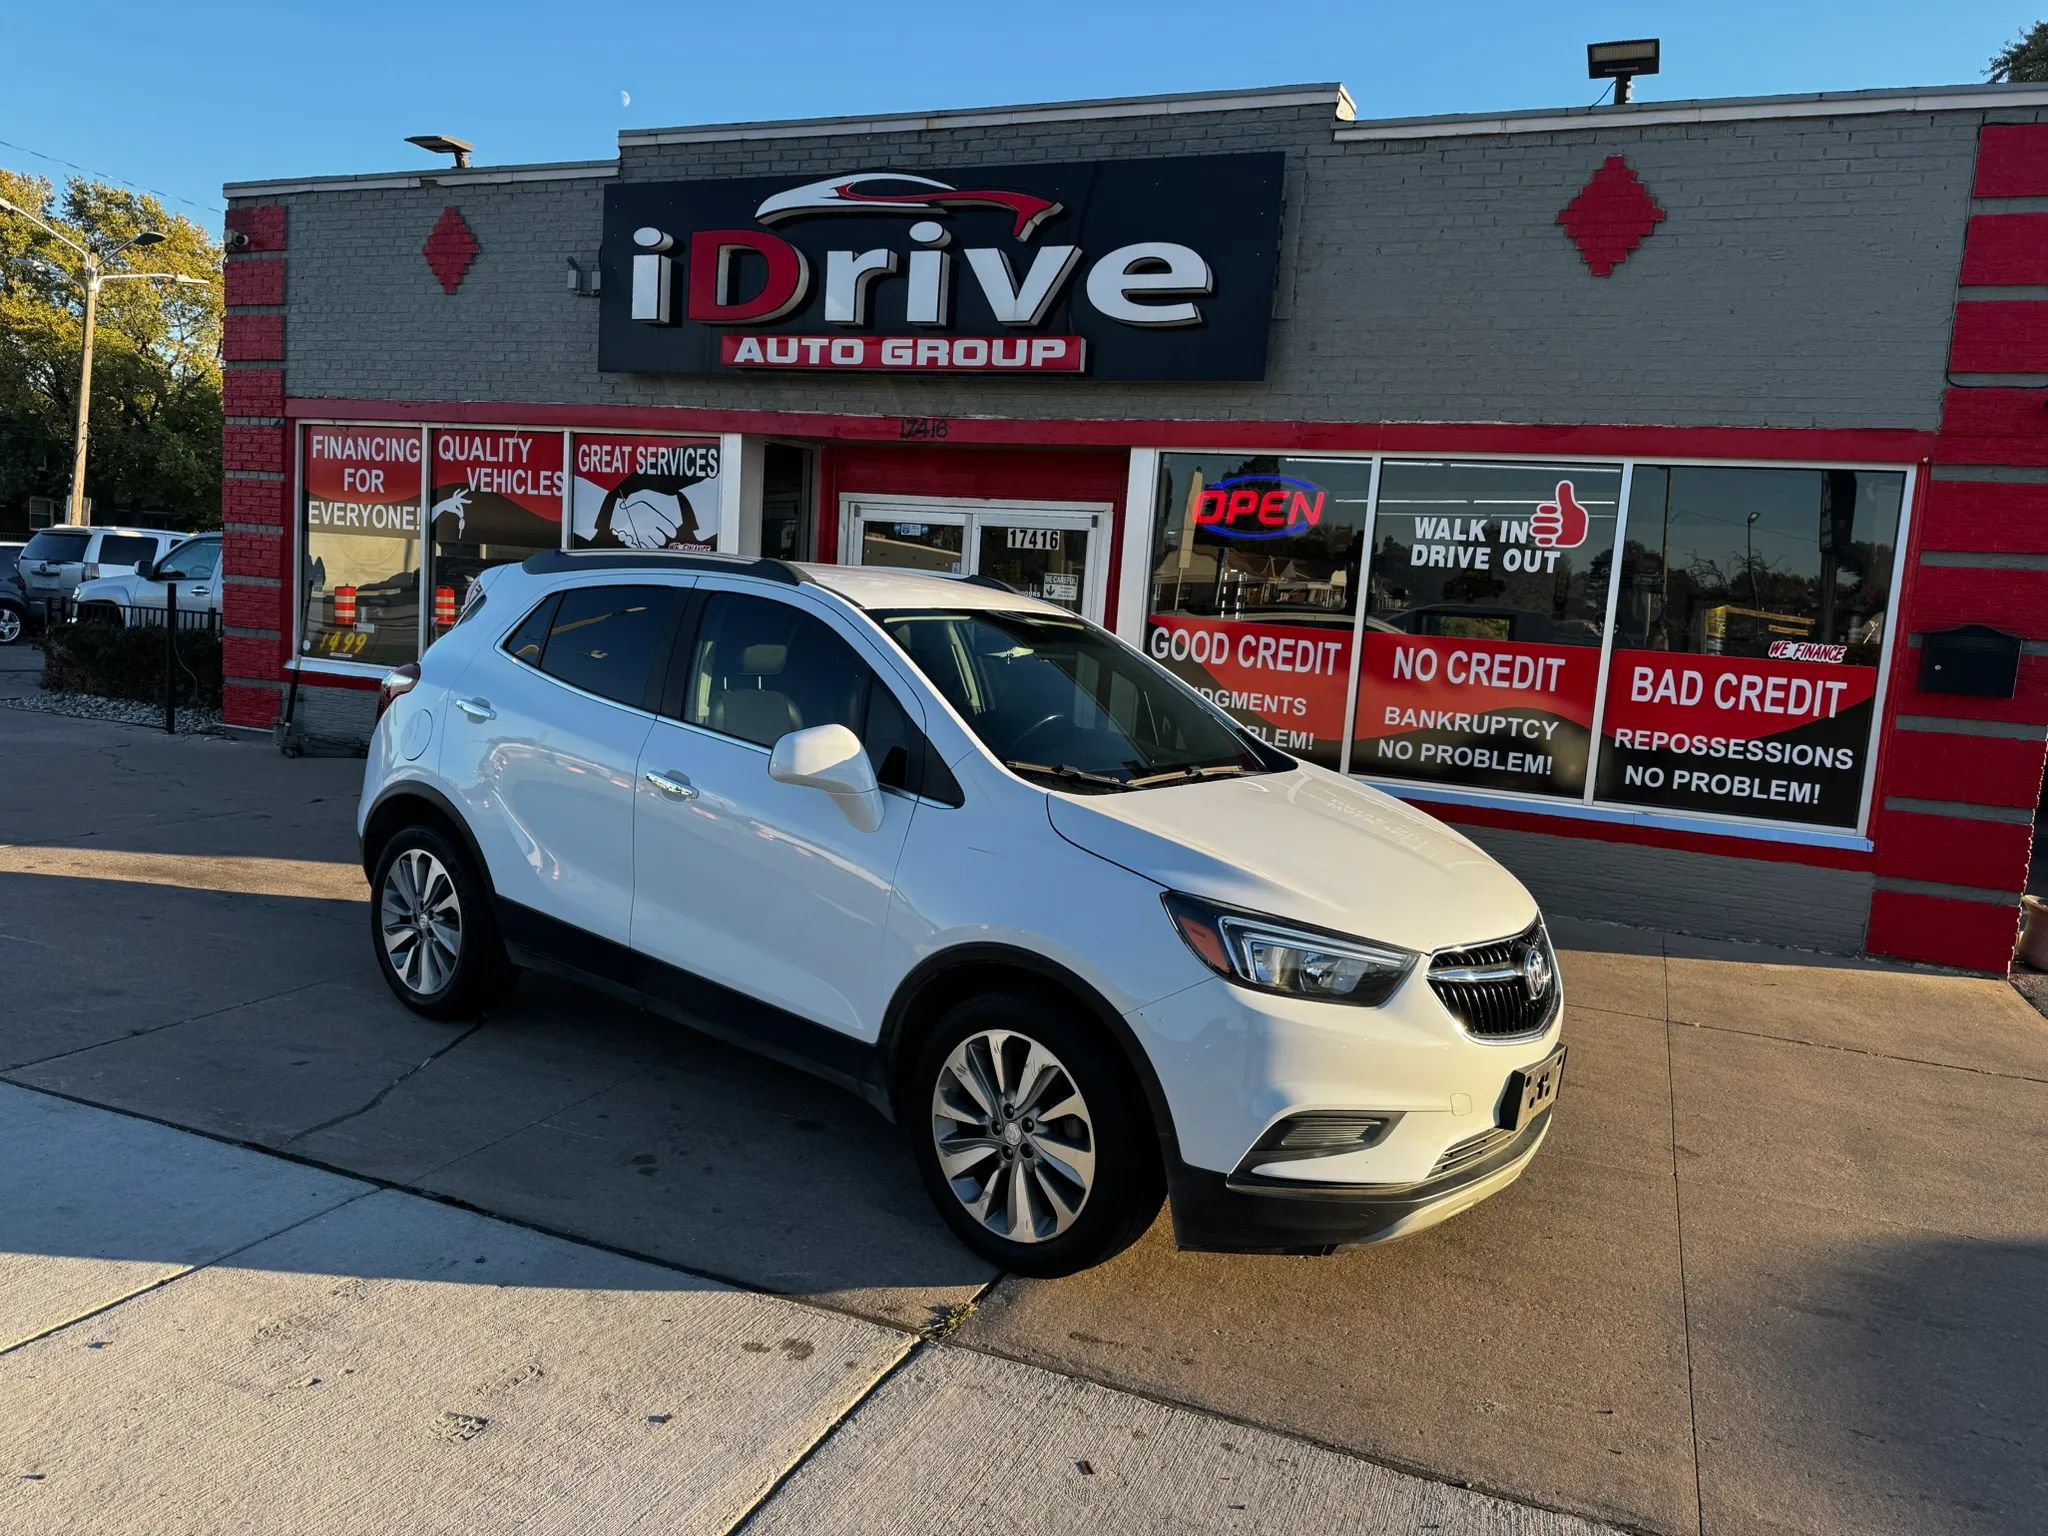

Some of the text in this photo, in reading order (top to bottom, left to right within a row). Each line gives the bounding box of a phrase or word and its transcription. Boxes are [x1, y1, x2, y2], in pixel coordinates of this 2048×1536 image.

[631, 219, 1213, 327] iDrive
[733, 338, 1067, 368] AUTO GROUP
[312, 435, 421, 463] FINANCING
[438, 436, 532, 464] QUALITY
[578, 444, 719, 477] GREAT SERVICES
[343, 468, 385, 493] FOR
[467, 467, 564, 496] VEHICLES
[308, 501, 420, 530] EVERYONE!
[1191, 489, 1327, 526] OPEN
[1009, 529, 1059, 549] 17416
[1414, 517, 1529, 544] WALK IN
[1410, 544, 1560, 573] DRIVE OUT
[1150, 627, 1342, 676] GOOD CREDIT
[1769, 642, 1847, 663] WE FINANCE
[1393, 646, 1566, 692] NO CREDIT
[1195, 687, 1307, 716] DGMENTS
[1631, 666, 1848, 718] BAD CREDIT
[1384, 706, 1559, 741] BANKRUPTCY
[1378, 738, 1553, 775] NO PROBLEM!
[1614, 728, 1853, 770] REPOSSESSIONS
[1624, 765, 1821, 804] NO PROBLEM!
